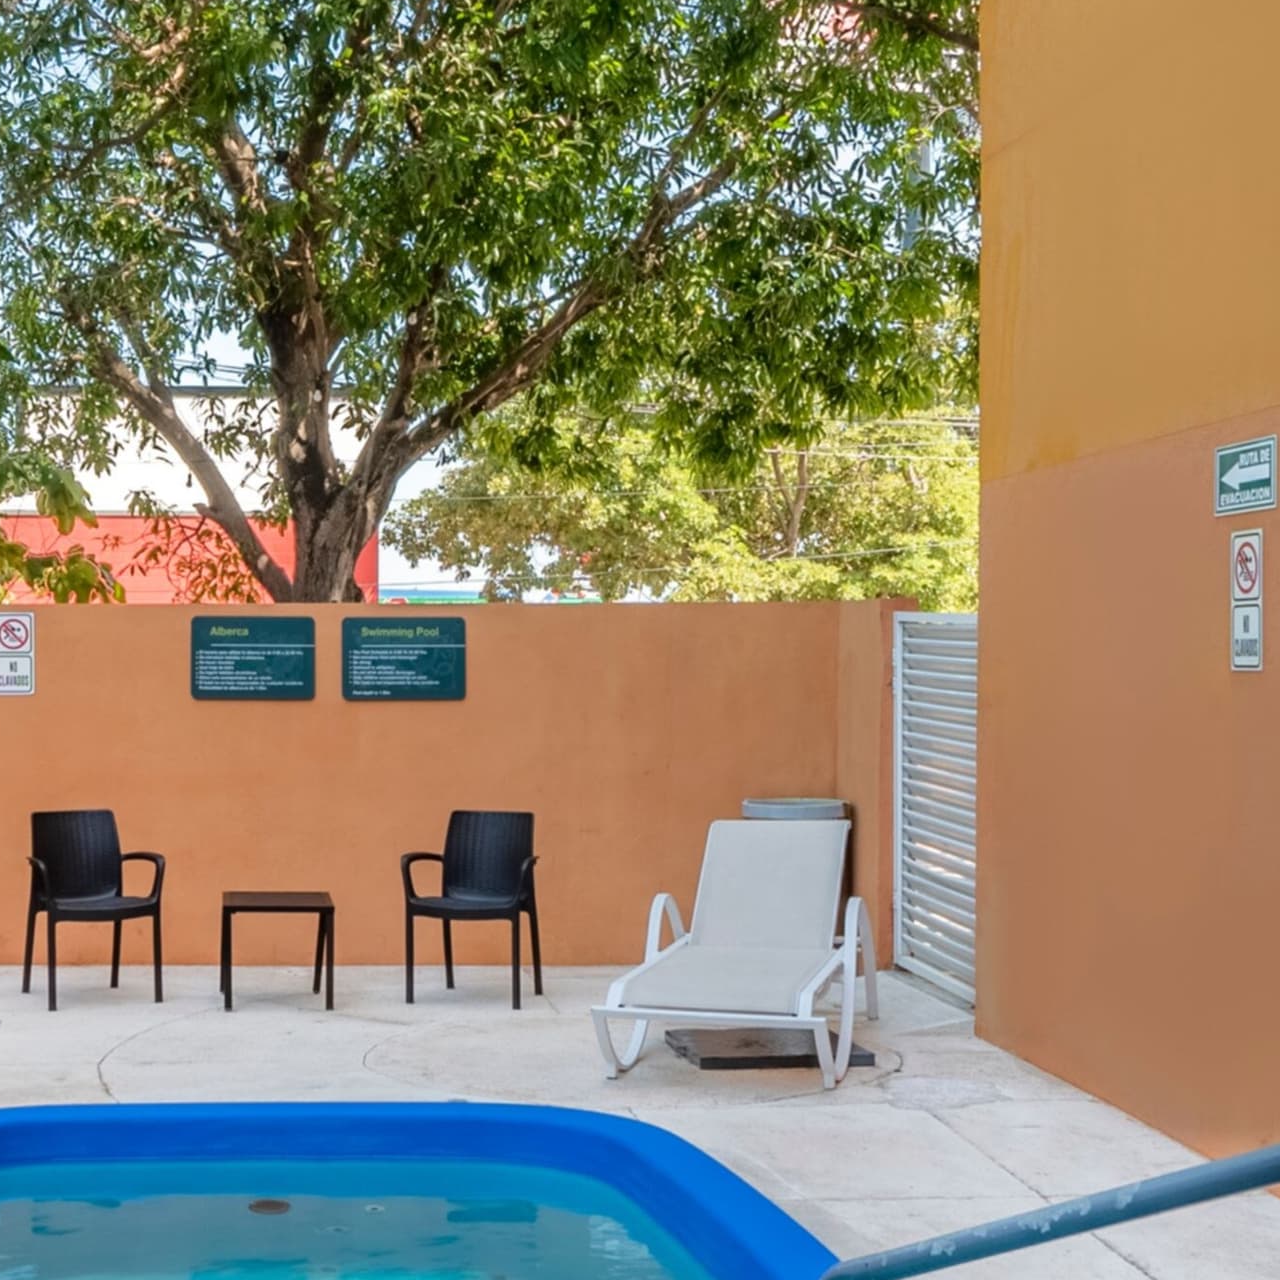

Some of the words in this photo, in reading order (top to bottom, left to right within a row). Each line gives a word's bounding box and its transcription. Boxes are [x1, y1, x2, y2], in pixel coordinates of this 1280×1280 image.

[209, 626, 249, 636] Alberca
[361, 626, 414, 639] Swimming
[415, 626, 439, 637] Pool
